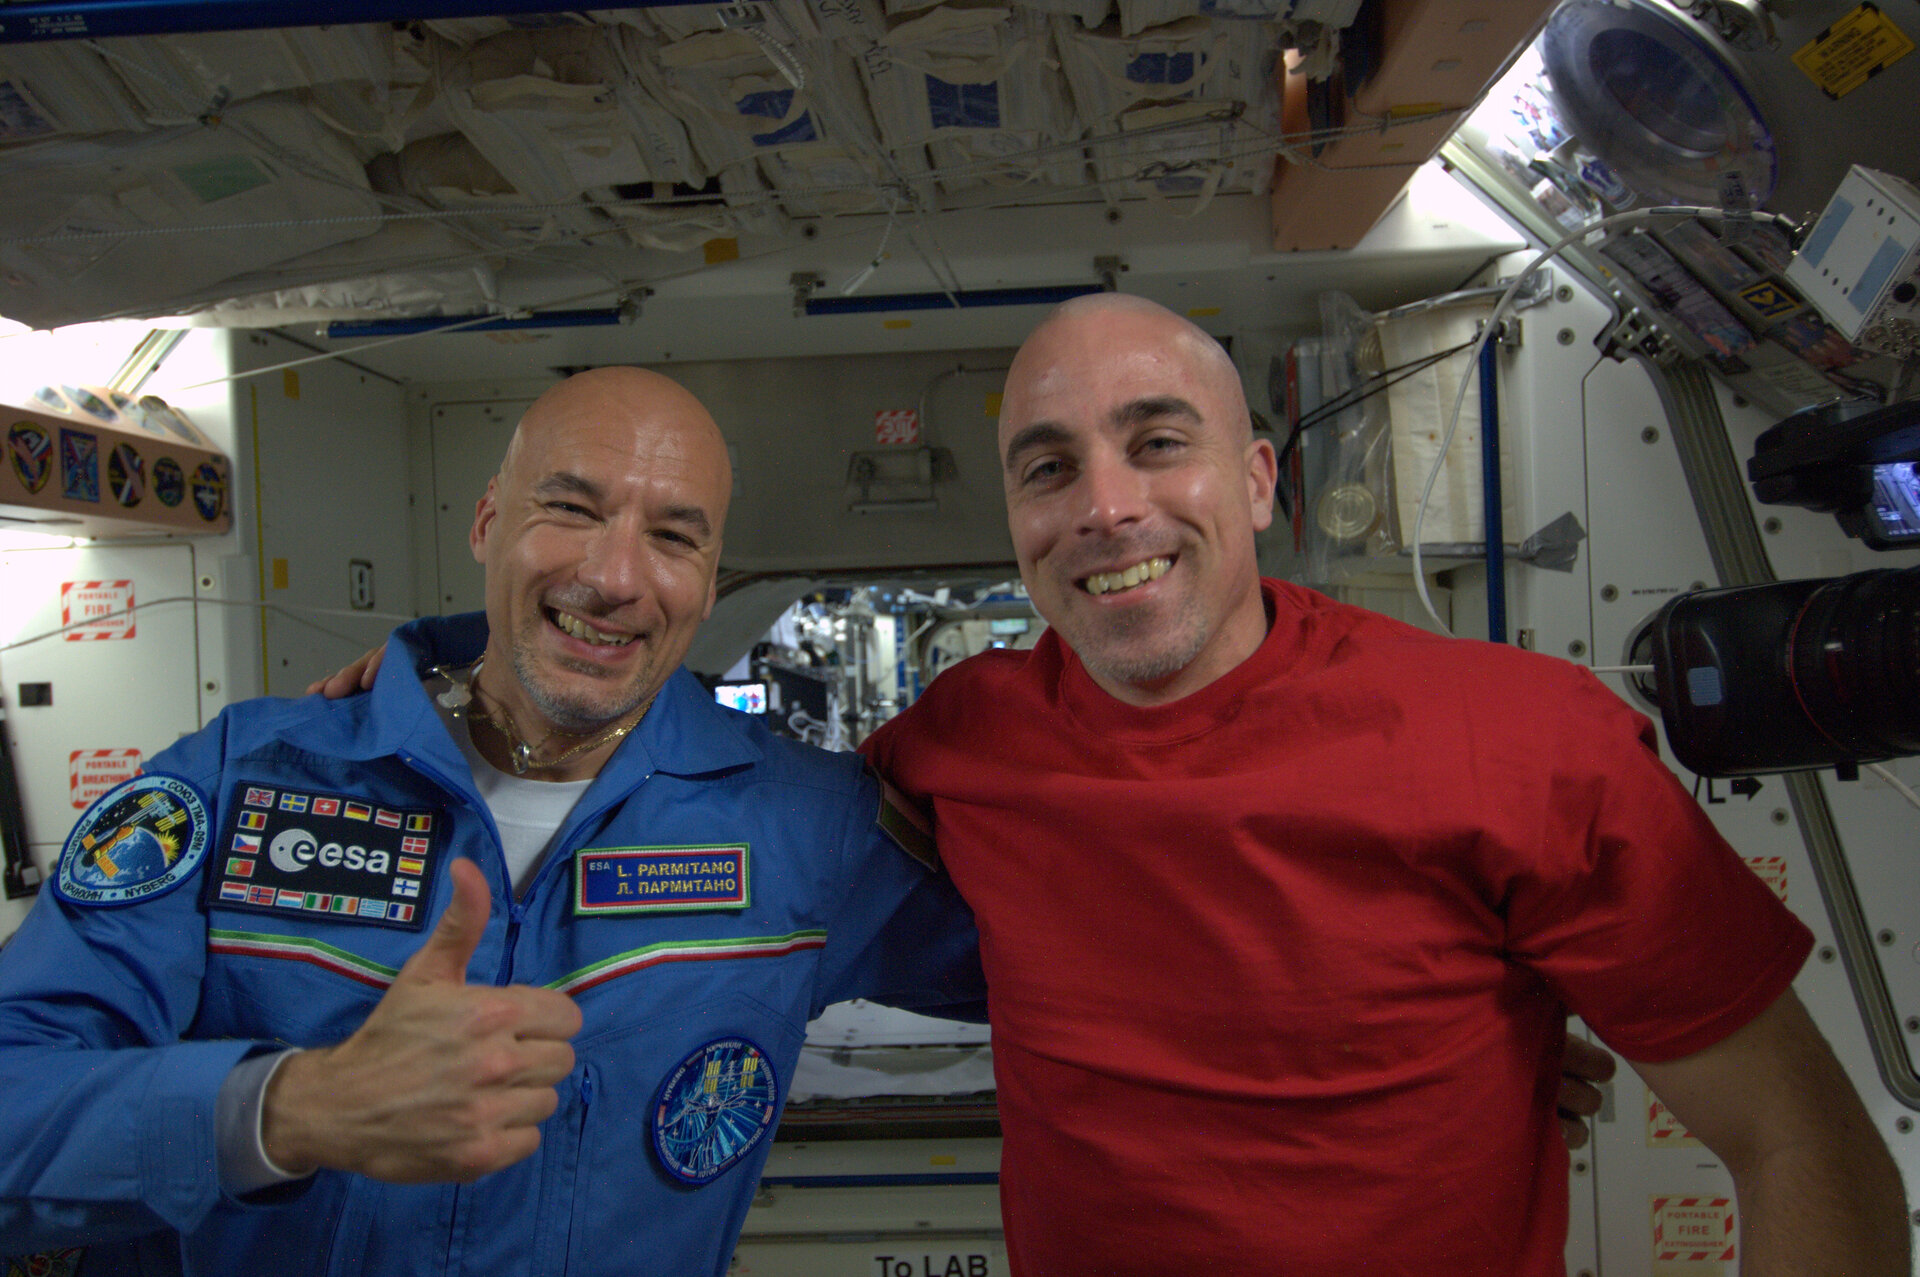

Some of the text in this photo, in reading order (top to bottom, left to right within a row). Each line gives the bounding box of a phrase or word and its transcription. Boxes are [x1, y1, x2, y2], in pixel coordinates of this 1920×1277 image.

[77, 592, 118, 600] PORTABLE
[84, 604, 112, 616] FIRE
[86, 760, 127, 769] PORTABLE
[167, 781, 197, 804] СОЮЗ
[588, 862, 611, 872] ESA
[616, 861, 736, 878] L. PARMITANO
[124, 872, 177, 898] NYBERG
[616, 878, 736, 895] Л. ПАРМИТАНО
[1667, 1212, 1720, 1220] PORTABLE
[1678, 1225, 1710, 1236] FIRE
[1664, 1240, 1724, 1248] EXTINGUISHER
[875, 1255, 988, 1277] To LAB
